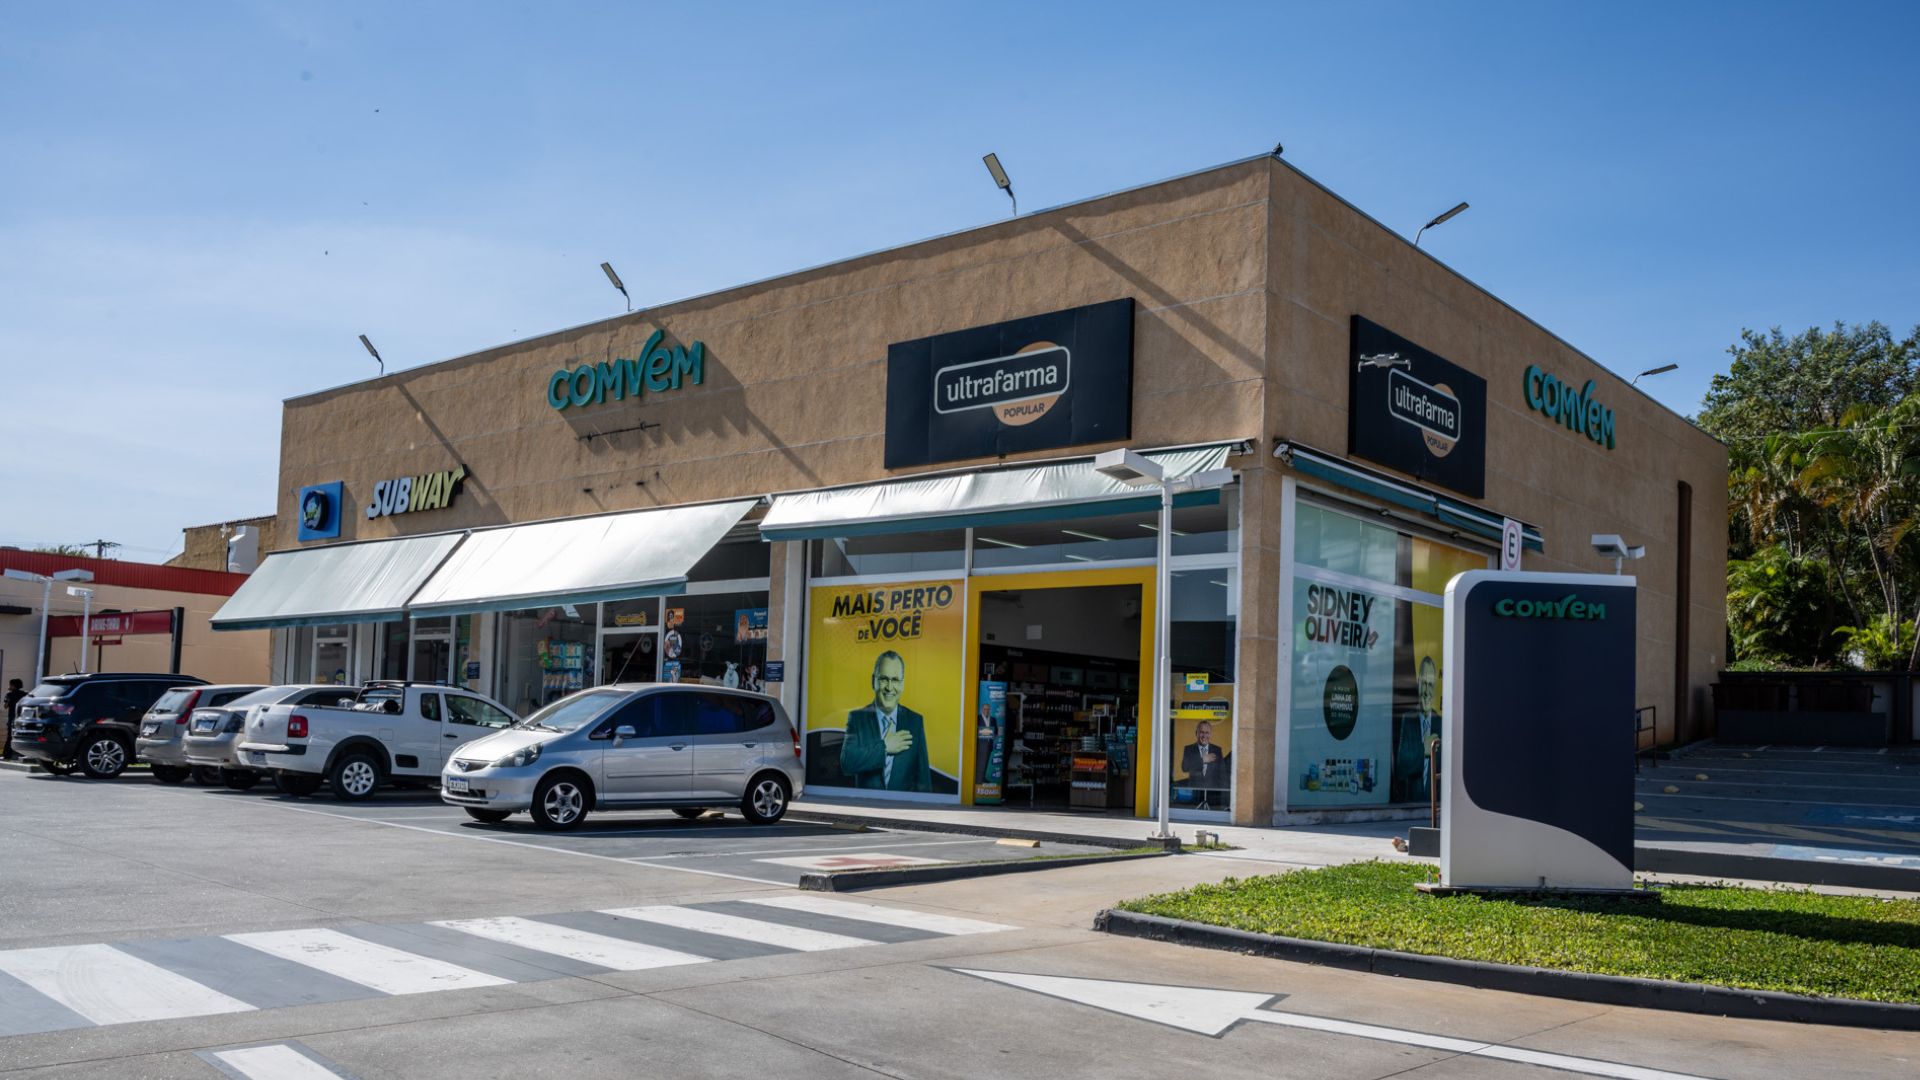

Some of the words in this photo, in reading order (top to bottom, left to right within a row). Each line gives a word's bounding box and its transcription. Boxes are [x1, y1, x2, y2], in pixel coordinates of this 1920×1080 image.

[946, 365, 1058, 402] ultrafarma
[1003, 402, 1045, 418] POPULAR
[1395, 384, 1455, 430] ultrafarma
[366, 464, 469, 520] SUBWAY
[1508, 532, 1516, 558] E
[832, 590, 885, 617] MAIS
[889, 585, 953, 611] PERTO
[1307, 584, 1375, 624] SIDNEY
[857, 629, 869, 640] DE
[869, 610, 922, 640] VOCÊ
